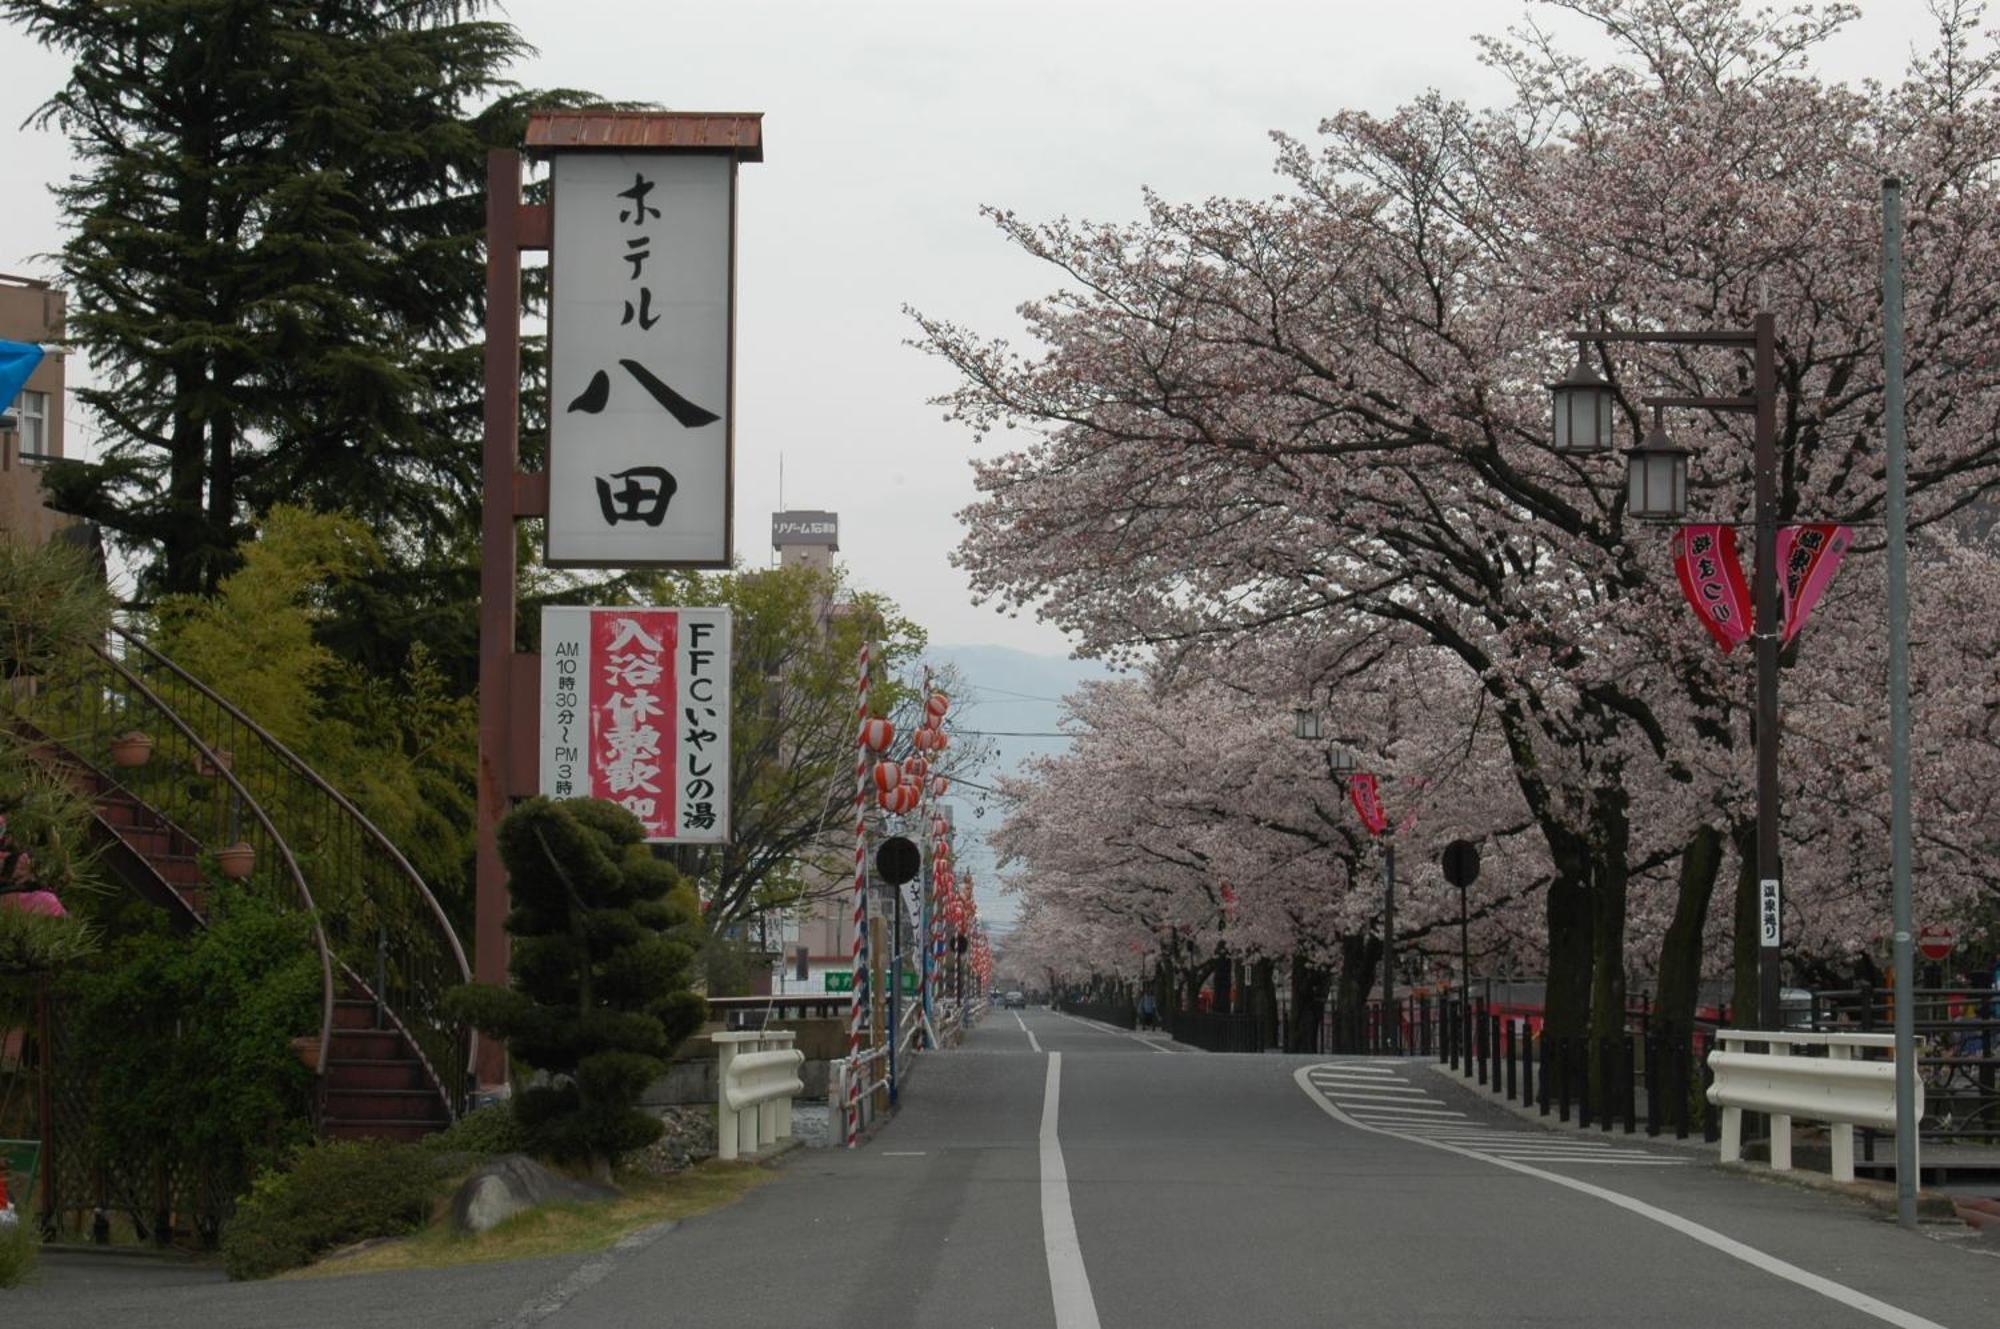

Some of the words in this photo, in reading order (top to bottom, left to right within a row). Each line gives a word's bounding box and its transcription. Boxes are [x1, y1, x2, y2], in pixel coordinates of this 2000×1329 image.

[567, 172, 722, 527] ホテル八田
[683, 623, 718, 831] FFCいやしの湯
